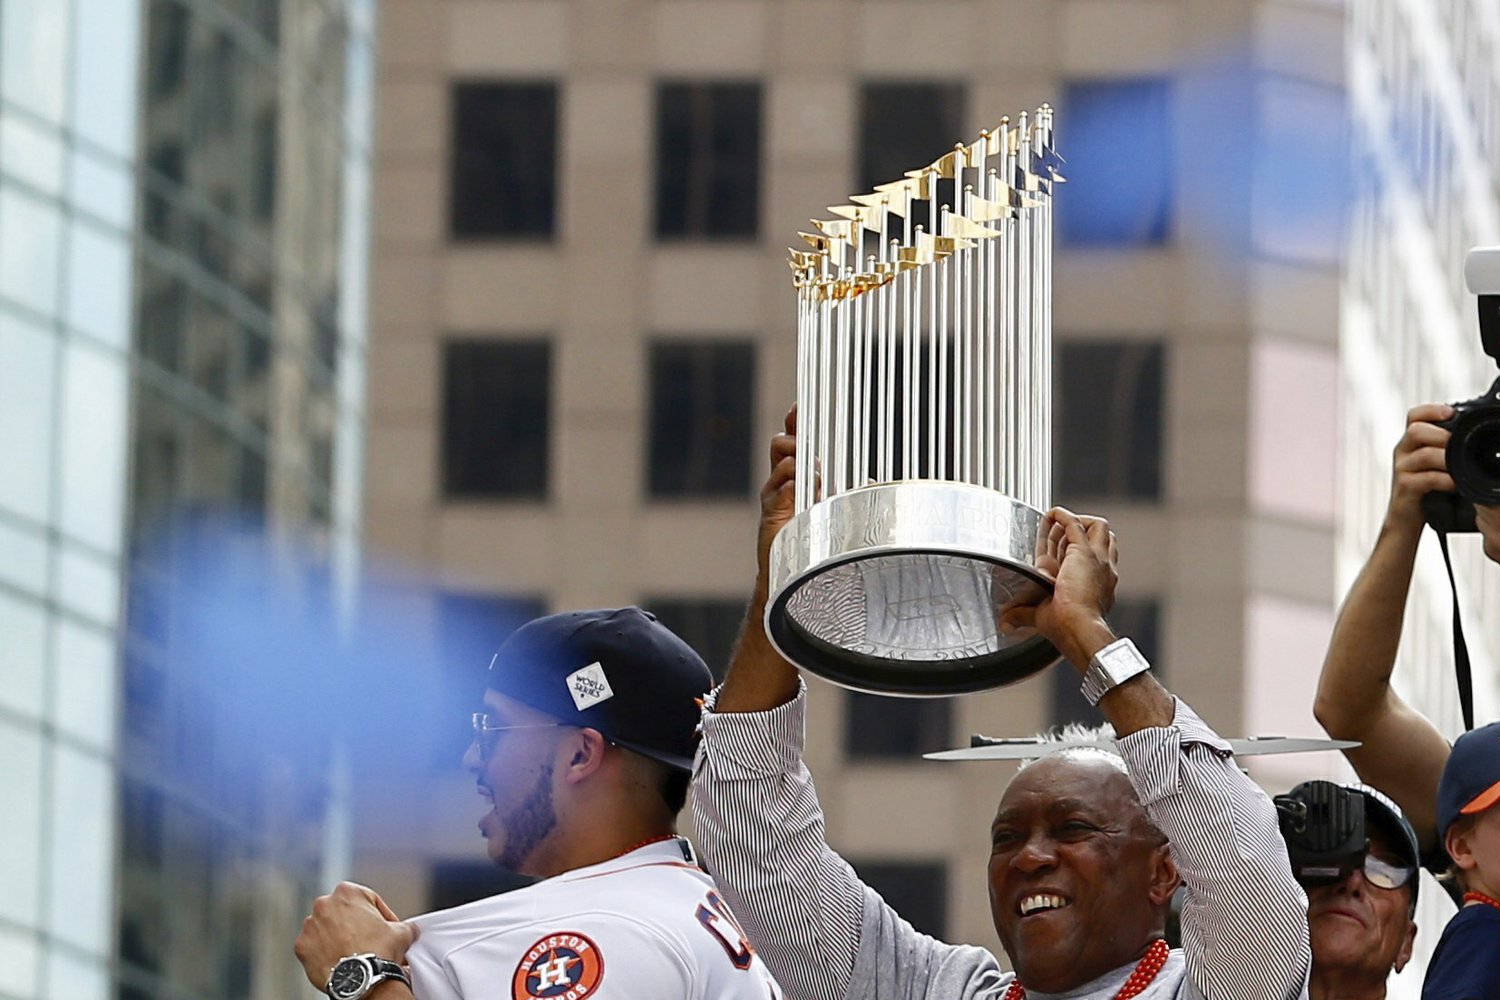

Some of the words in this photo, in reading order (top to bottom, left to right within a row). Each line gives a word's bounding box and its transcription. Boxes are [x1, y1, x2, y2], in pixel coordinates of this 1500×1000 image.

[574, 683, 600, 698] SERIES
[576, 675, 605, 691] WORLD
[522, 935, 589, 972] HOUSTON
[536, 956, 571, 990] H
